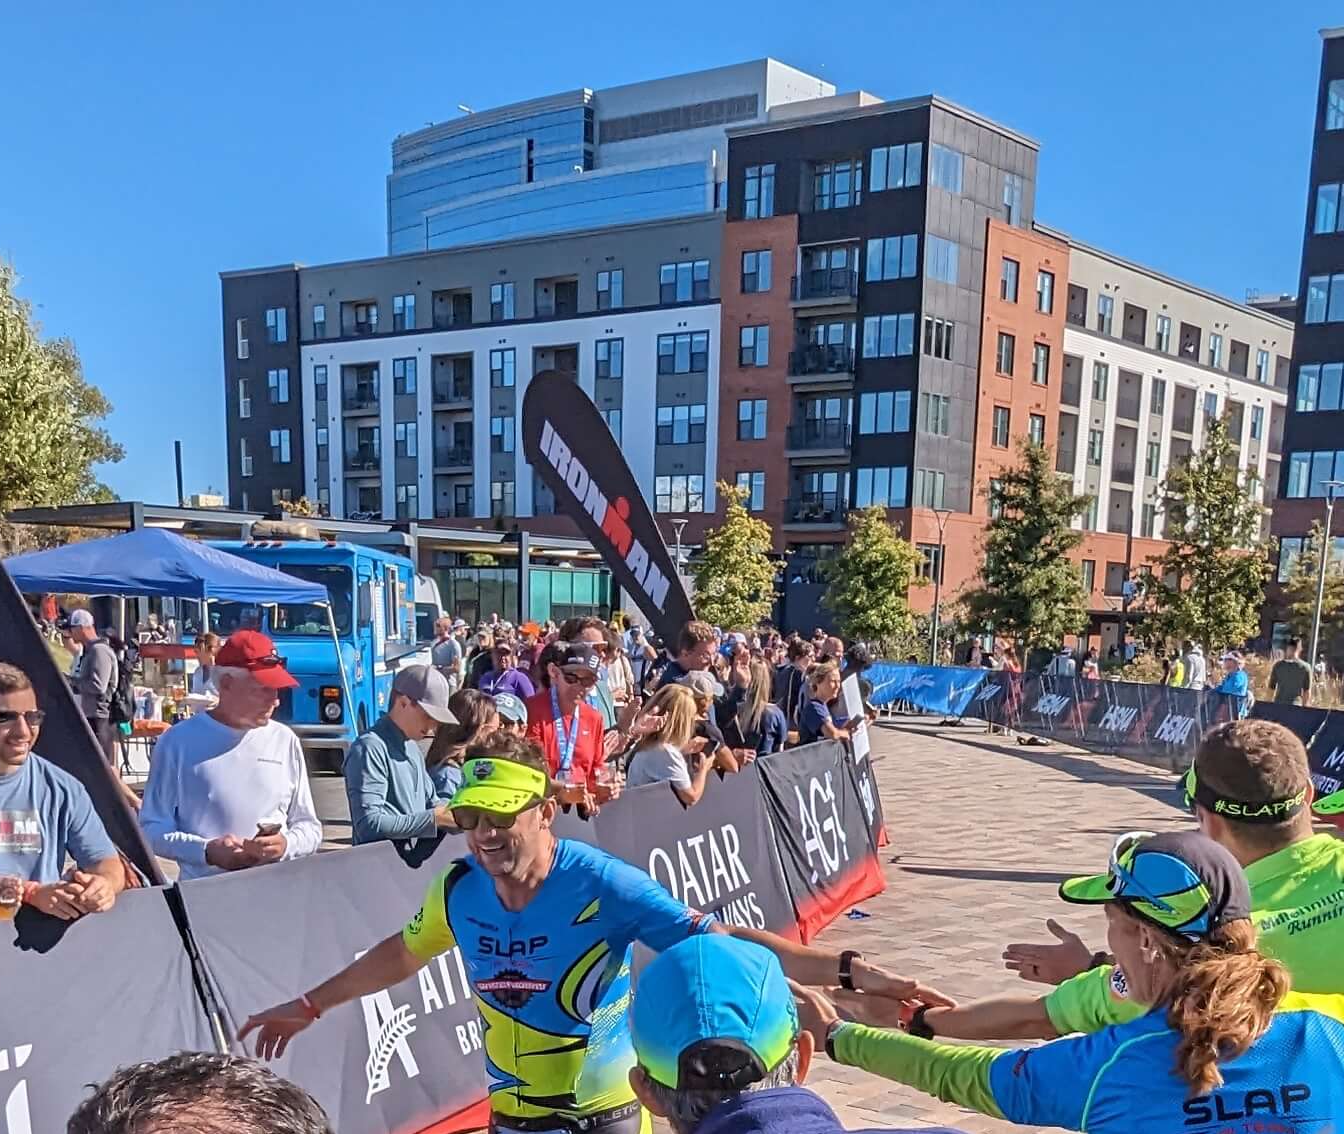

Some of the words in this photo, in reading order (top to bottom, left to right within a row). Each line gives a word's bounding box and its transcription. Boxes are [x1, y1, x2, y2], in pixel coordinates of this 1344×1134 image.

[538, 420, 671, 611] IRONMAN
[1215, 787, 1307, 817] #SLAPPE
[649, 823, 752, 907] QATAR
[477, 935, 548, 957] SLAP
[1183, 1083, 1311, 1125] SLAP
